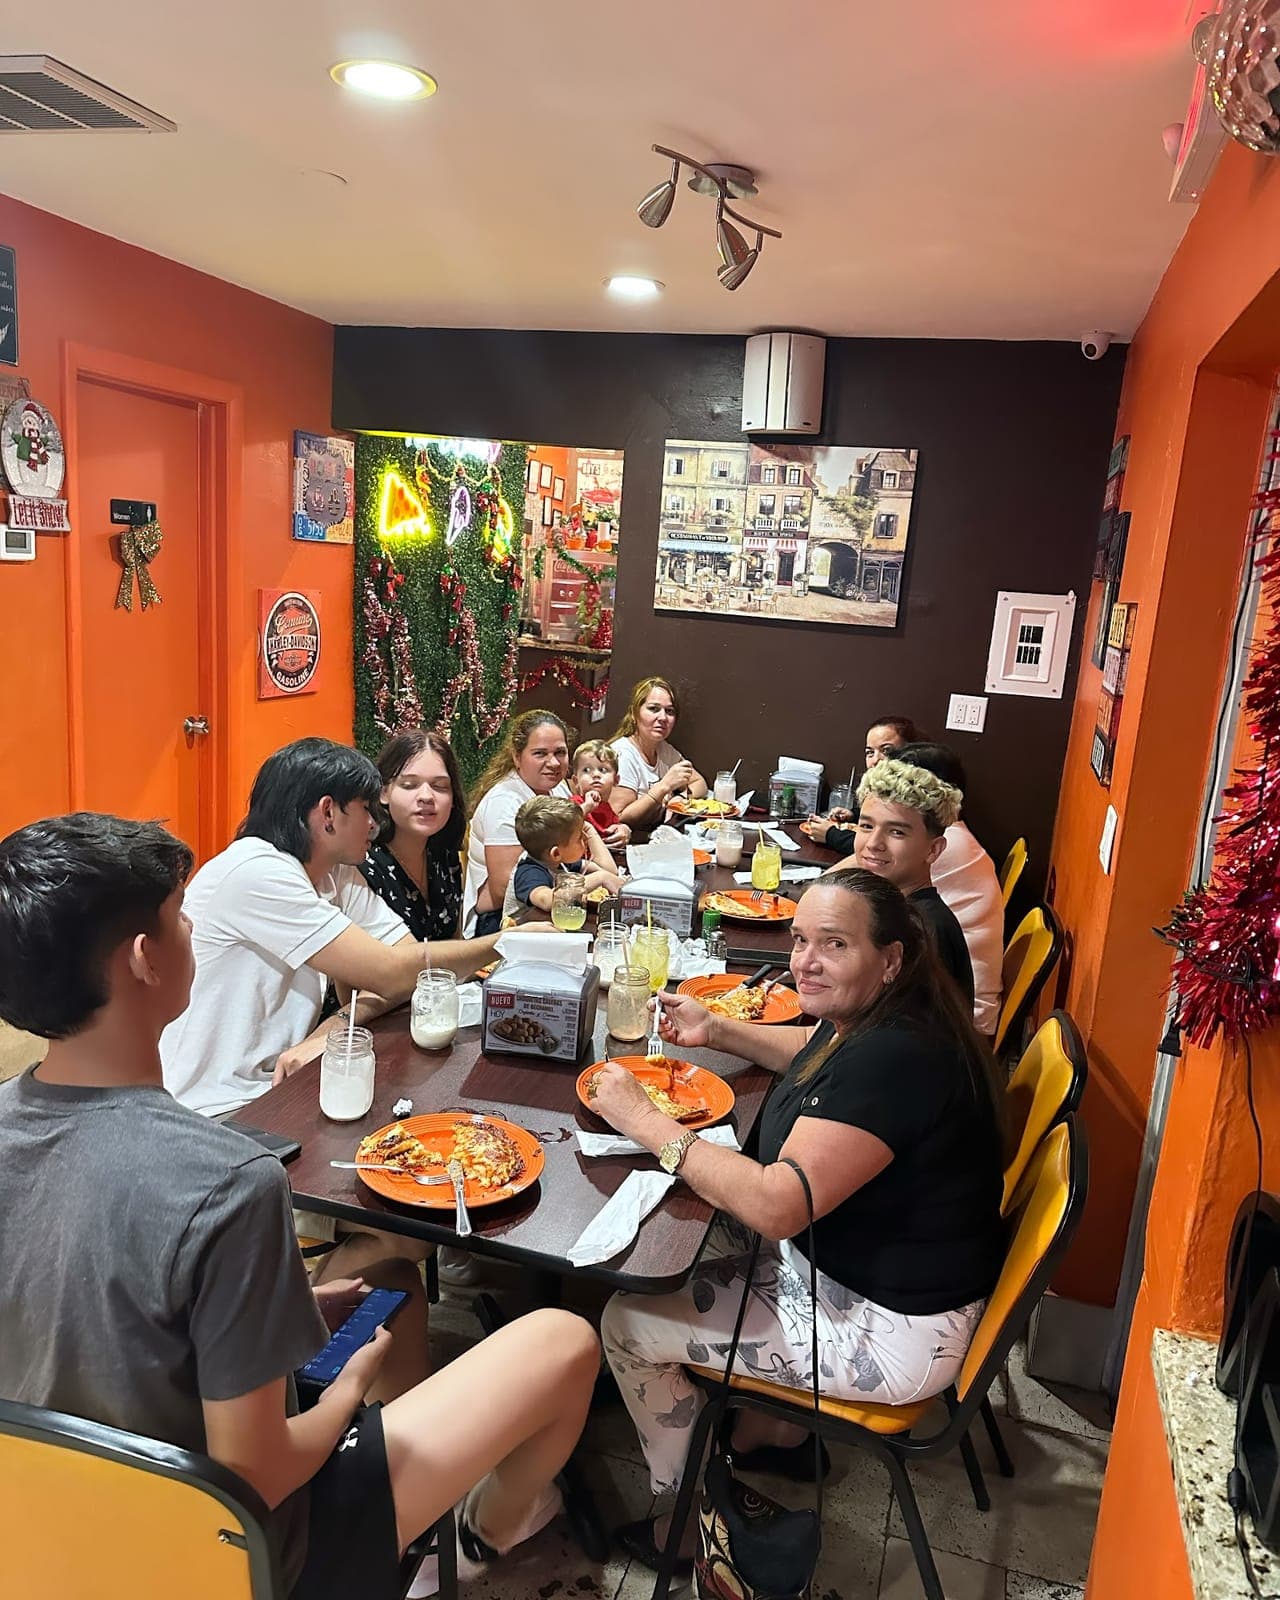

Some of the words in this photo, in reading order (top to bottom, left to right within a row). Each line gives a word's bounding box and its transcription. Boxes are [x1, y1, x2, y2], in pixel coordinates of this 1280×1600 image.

[268, 635, 317, 653] HARLEY-DAVIDSON
[276, 670, 310, 688] GASOLINE
[491, 995, 512, 1006] NUEVO
[490, 1009, 505, 1019] HOY
